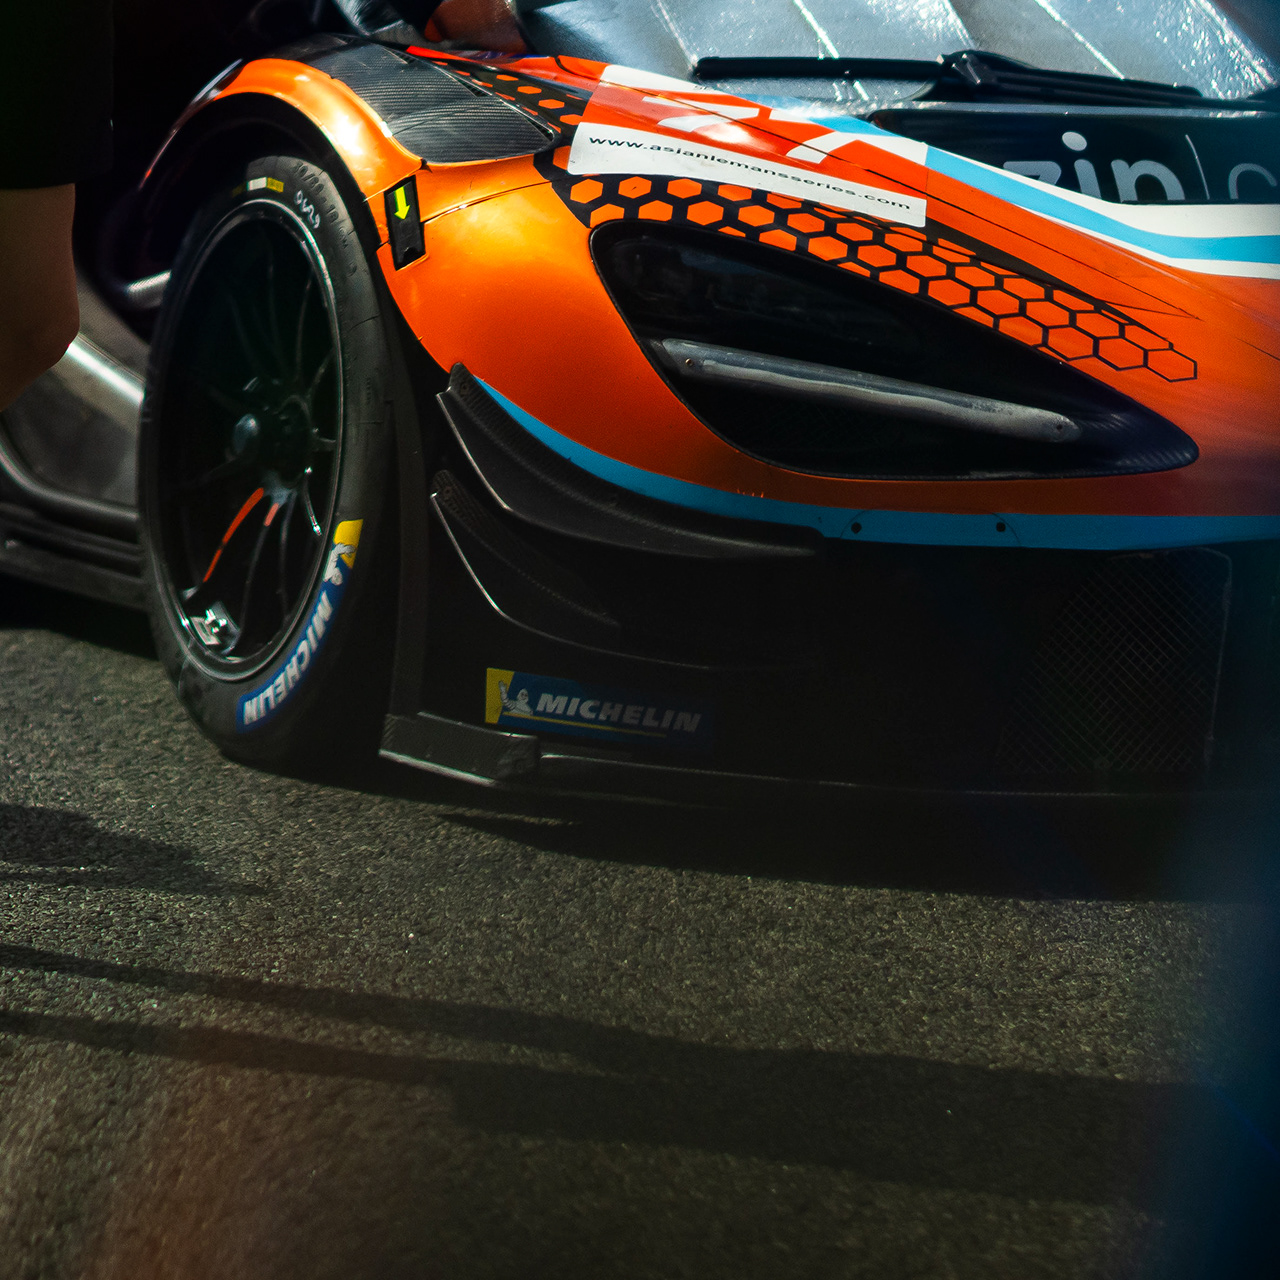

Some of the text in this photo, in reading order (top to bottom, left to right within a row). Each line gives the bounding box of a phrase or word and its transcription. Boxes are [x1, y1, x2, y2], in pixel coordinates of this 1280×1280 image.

[589, 137, 910, 210] www.asianlemansseries.com
[243, 591, 333, 725] MICHELIN
[536, 693, 702, 733] MICHELIN
